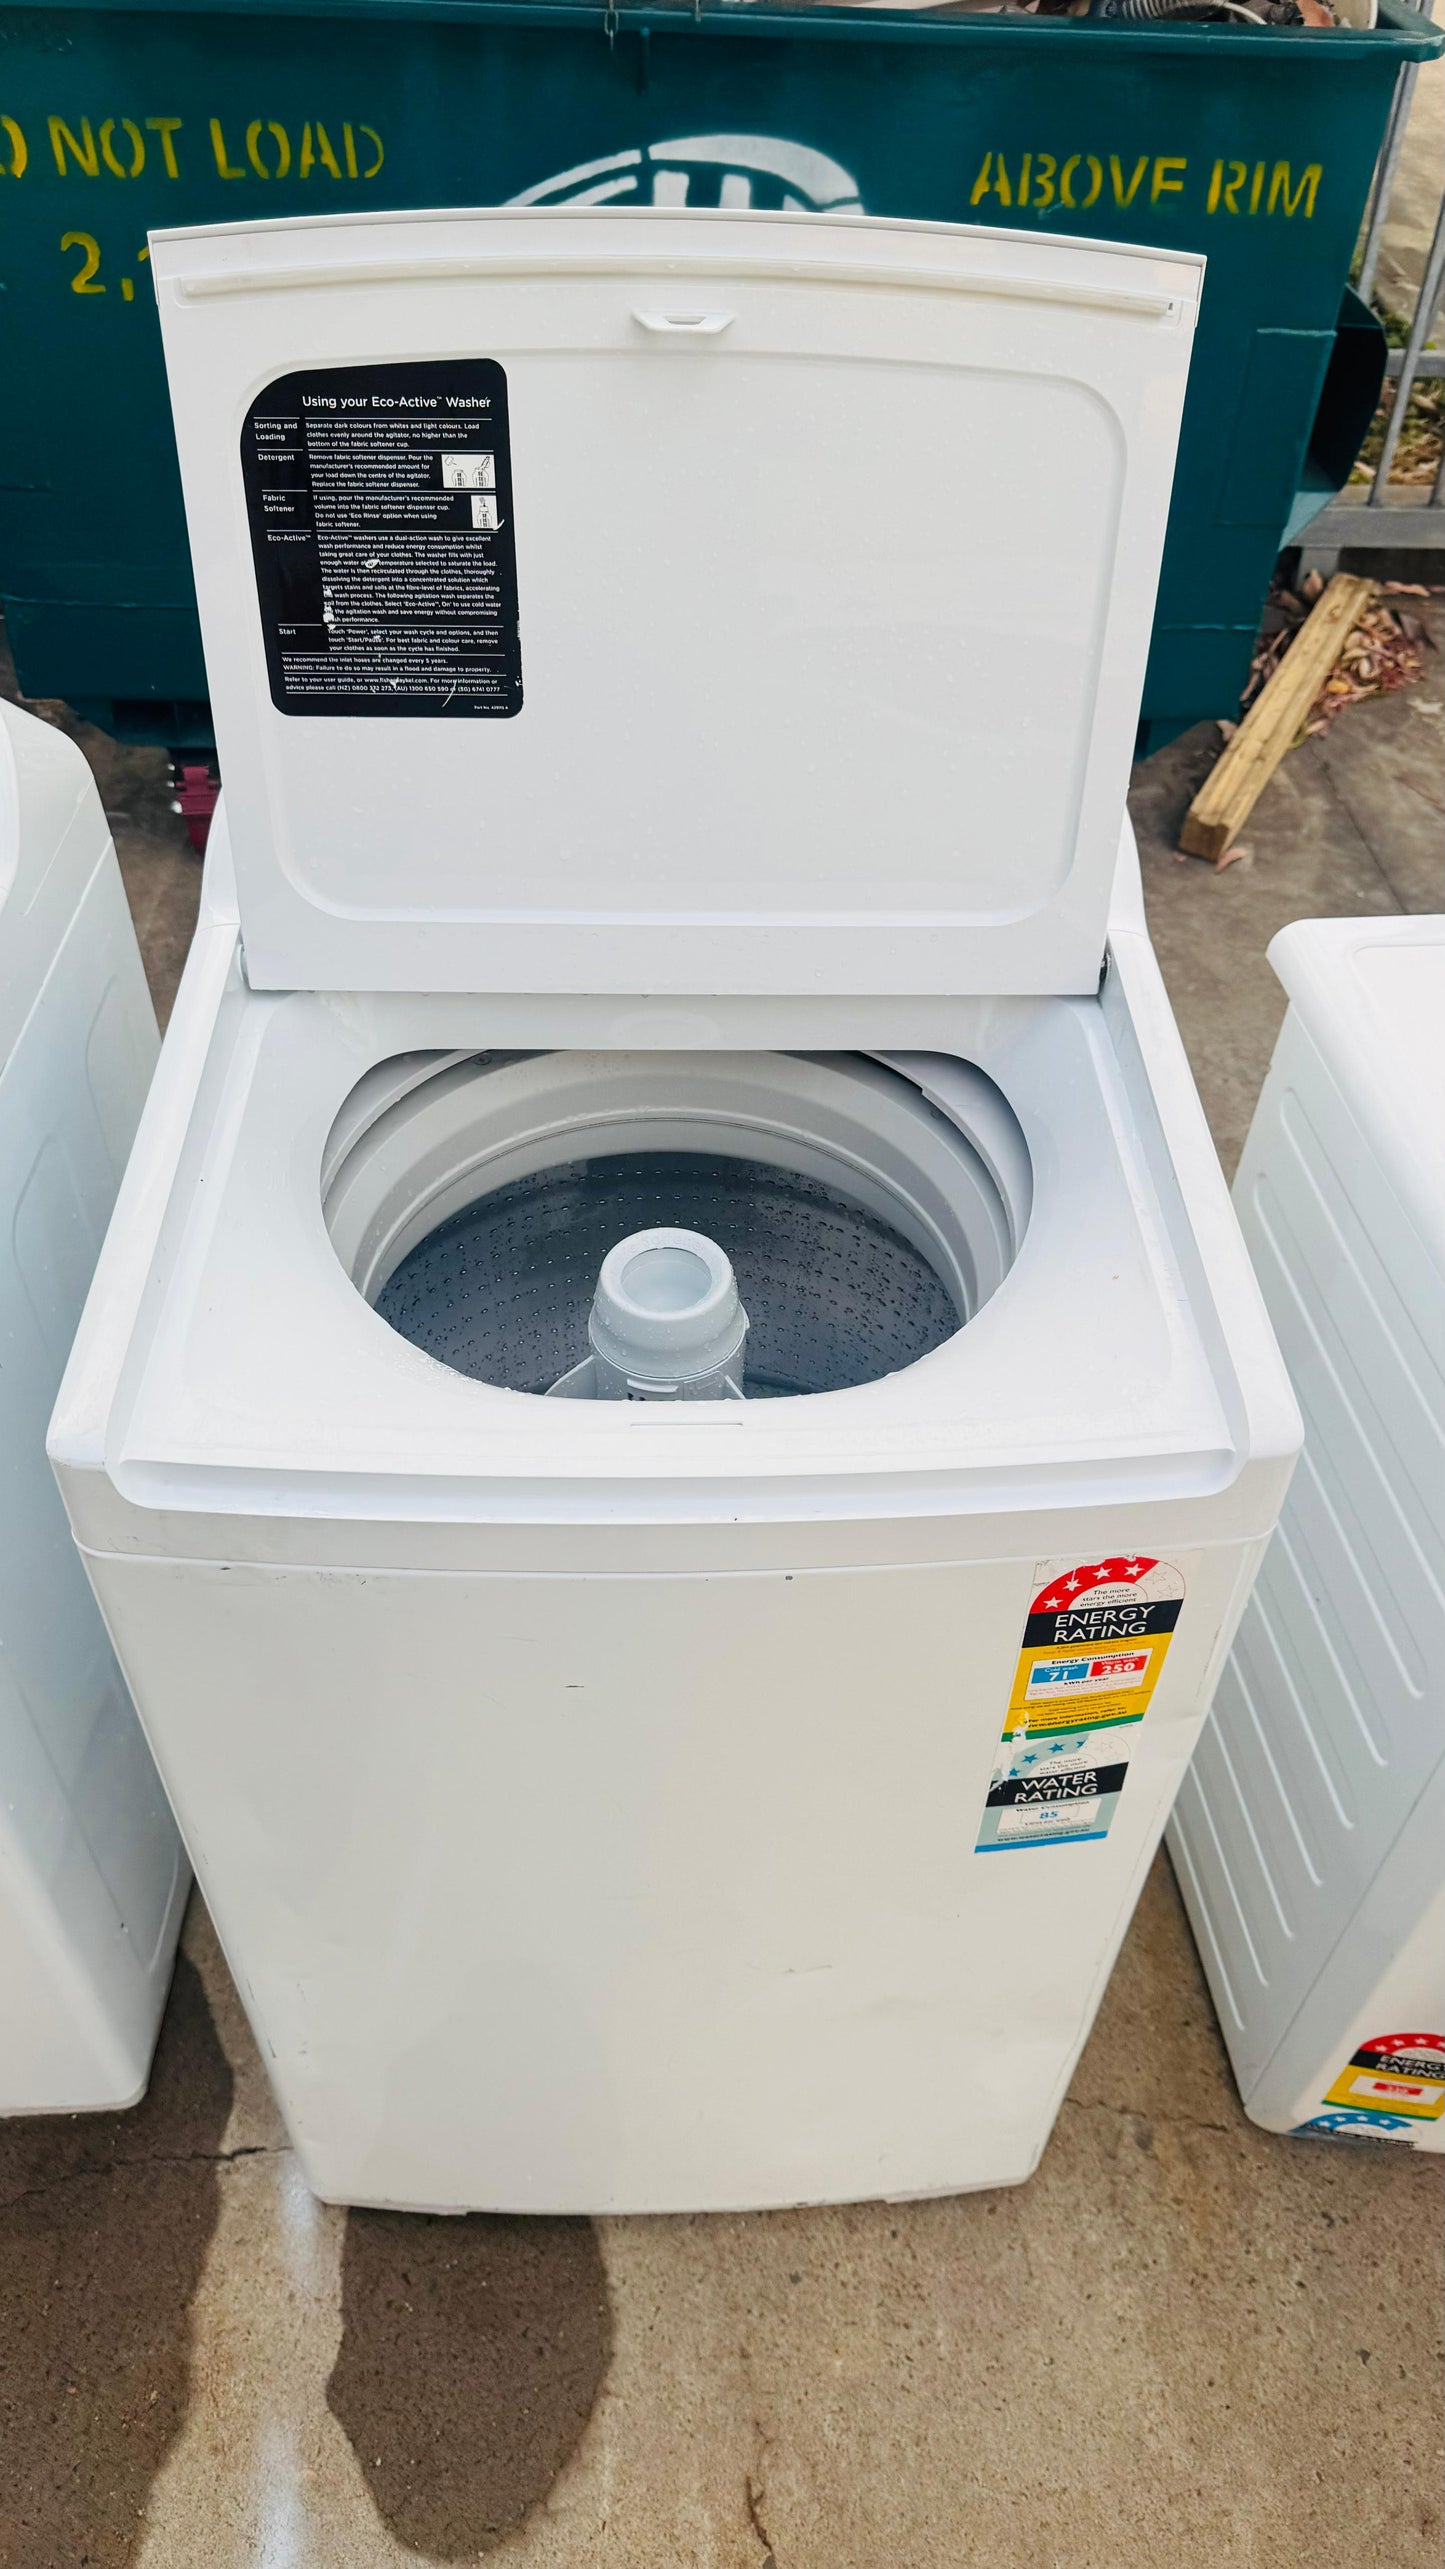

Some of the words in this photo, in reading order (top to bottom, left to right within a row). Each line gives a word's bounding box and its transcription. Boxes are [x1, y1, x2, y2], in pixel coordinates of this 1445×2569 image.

[47, 115, 183, 179] NOT
[209, 117, 385, 179] LOAD
[969, 152, 1187, 209] ABOVE
[1206, 158, 1323, 218] RIM
[302, 396, 336, 408] Using
[340, 397, 367, 408] your
[445, 396, 491, 407] Washer
[254, 422, 281, 431] Sorting
[255, 434, 286, 442] Loading
[258, 454, 295, 462] Detergent
[278, 628, 296, 636] Start
[1055, 1605, 1156, 1628] ENERGY
[1053, 1621, 1148, 1643] RATING
[1081, 1652, 1134, 1662] Consumption
[1101, 1662, 1136, 1676] 250
[1049, 1671, 1069, 1682] 71
[1021, 1771, 1098, 1791] WATER
[1014, 1783, 1099, 1804] RATING
[1040, 1810, 1058, 1820] 85
[1380, 2055, 1445, 2071] ENERG
